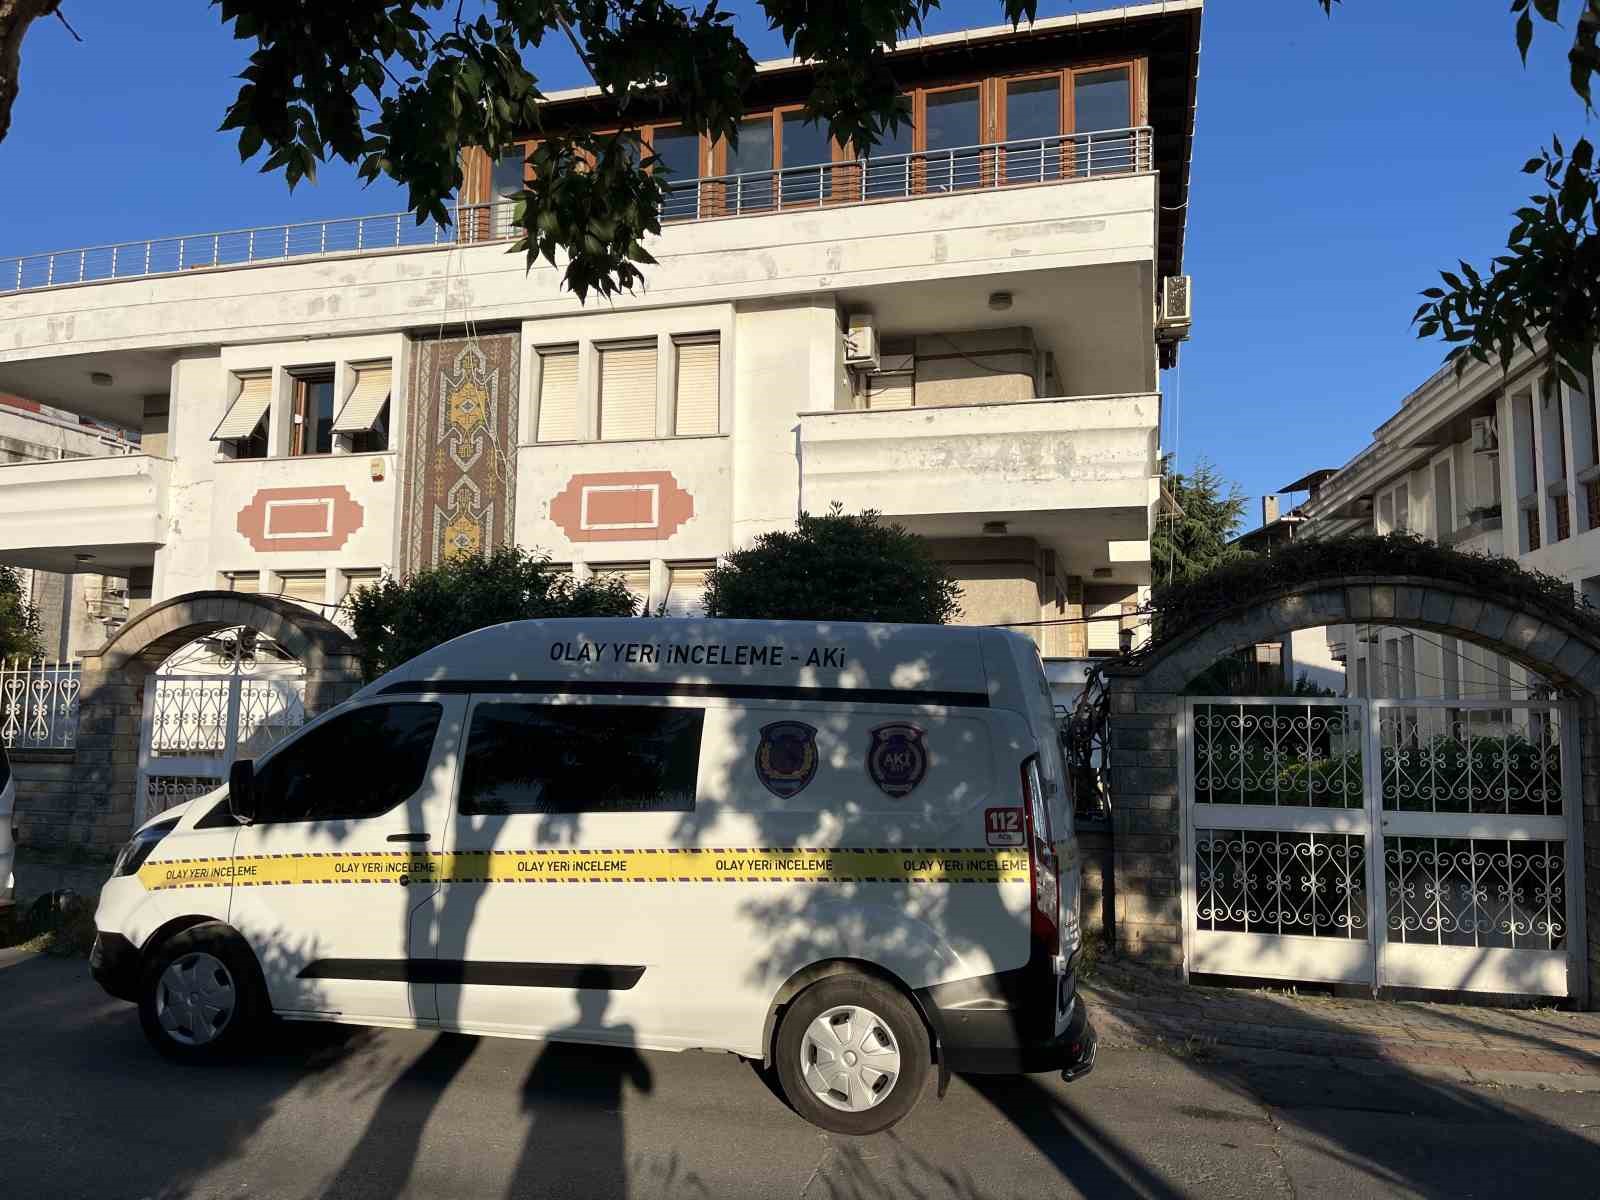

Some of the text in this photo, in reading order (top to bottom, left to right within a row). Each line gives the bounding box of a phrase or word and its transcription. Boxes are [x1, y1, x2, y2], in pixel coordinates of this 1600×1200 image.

[550, 643, 606, 662] OLAY
[990, 811, 1018, 831] 112
[335, 863, 361, 873] OLAY
[517, 861, 544, 872] OLAY
[715, 860, 745, 871] OLAY
[903, 860, 934, 871] OLAY
[166, 870, 188, 880] OLAY
